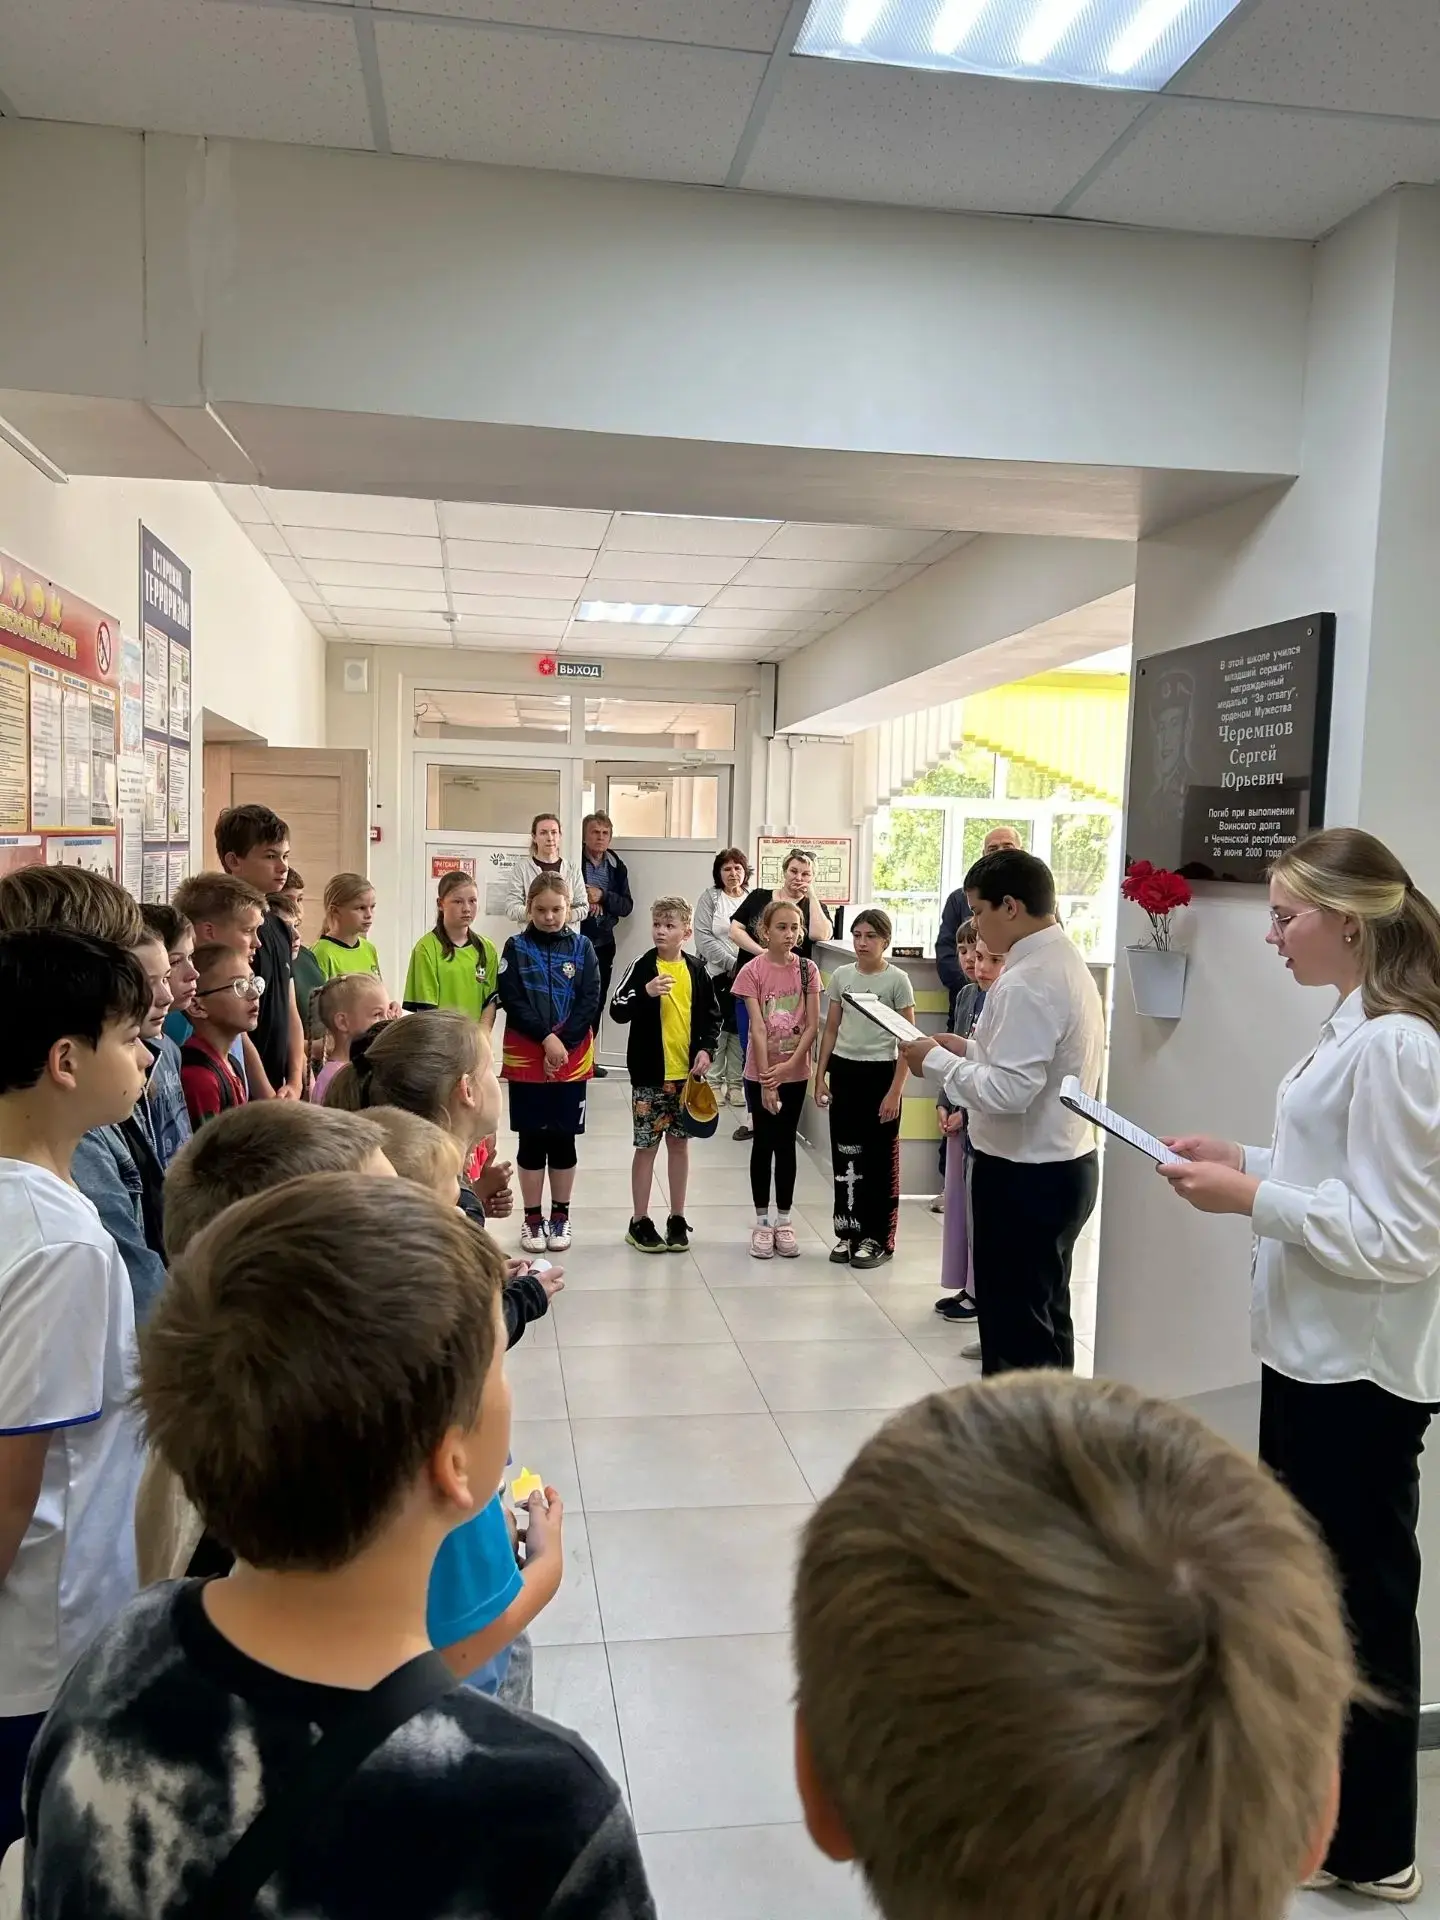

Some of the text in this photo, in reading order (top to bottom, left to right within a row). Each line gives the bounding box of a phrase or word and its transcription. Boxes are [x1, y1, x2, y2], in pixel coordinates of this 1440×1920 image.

[1220, 645, 1300, 670] В этой школе учился
[559, 665, 599, 676] ВЫХОД
[1224, 666, 1257, 682] младший
[1230, 675, 1285, 694] награжденный
[1217, 697, 1248, 710] медалью
[1221, 703, 1292, 723] орденом Мужества
[1218, 721, 1293, 746] Черемнов
[1229, 743, 1277, 768] Сергей
[1220, 771, 1284, 792] Юрьевич
[1208, 807, 1295, 819] Погиб при выполнении
[1219, 821, 1281, 831] Воинского долга
[1204, 833, 1297, 846] в Чеченской республике
[1213, 847, 1222, 857] 26
[1224, 848, 1243, 857] июня
[1245, 847, 1263, 857] 2000
[578, 1099, 586, 1125] 7
